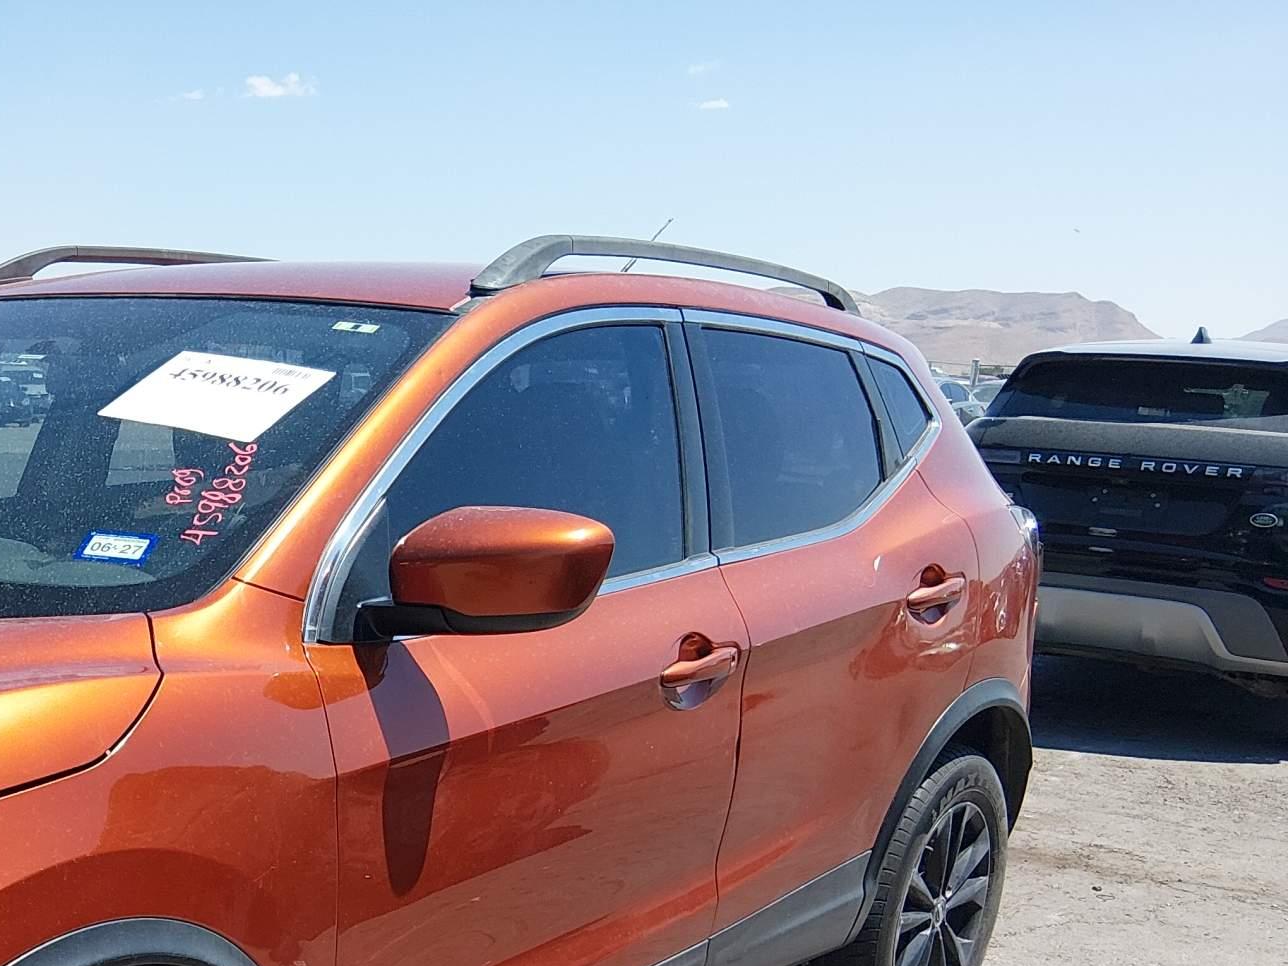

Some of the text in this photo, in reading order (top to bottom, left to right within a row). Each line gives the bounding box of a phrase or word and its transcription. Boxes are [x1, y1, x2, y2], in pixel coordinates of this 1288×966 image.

[169, 367, 292, 395] 45988206
[1027, 452, 1244, 479] RANGE ROVER
[180, 442, 258, 546] 45988206
